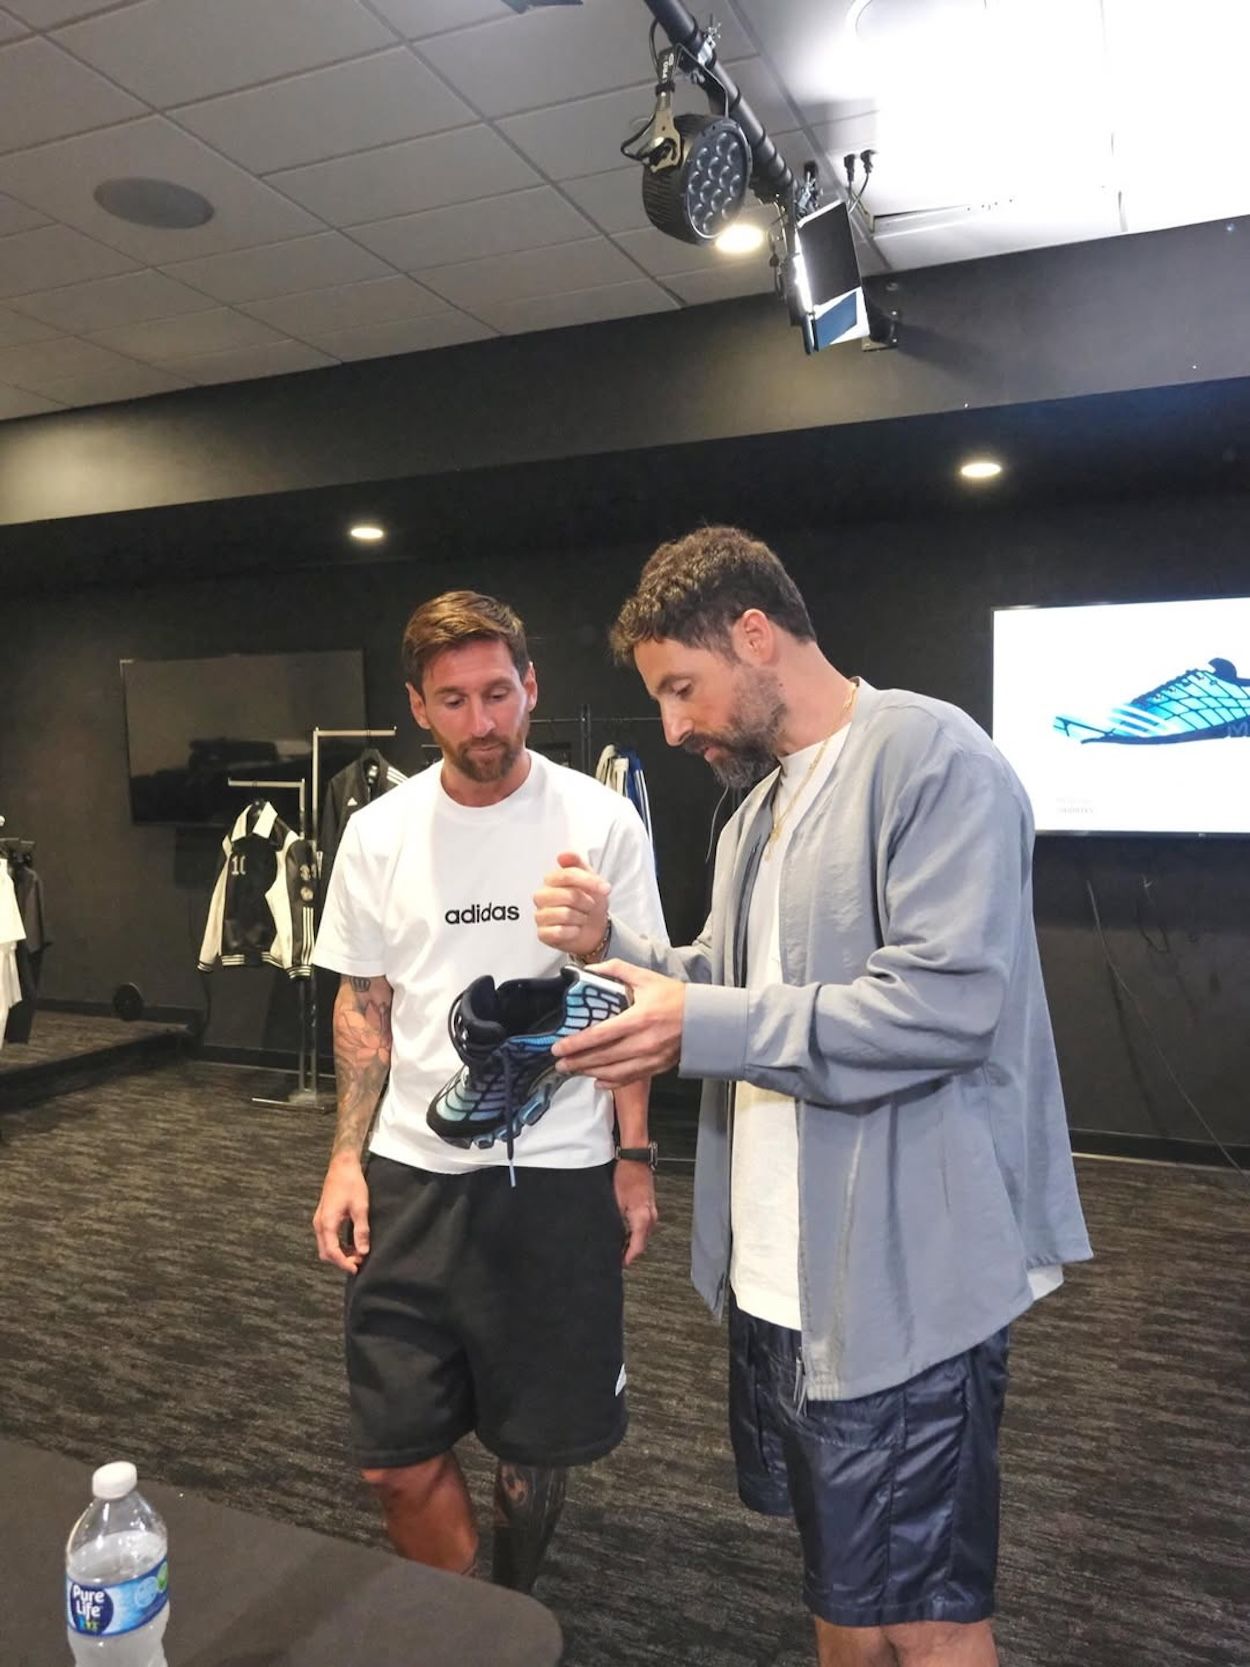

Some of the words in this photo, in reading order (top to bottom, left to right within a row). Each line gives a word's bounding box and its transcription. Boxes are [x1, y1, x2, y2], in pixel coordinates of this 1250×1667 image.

[445, 902, 520, 924] adidas
[73, 1584, 105, 1604] Pure
[76, 1600, 101, 1621] Life
